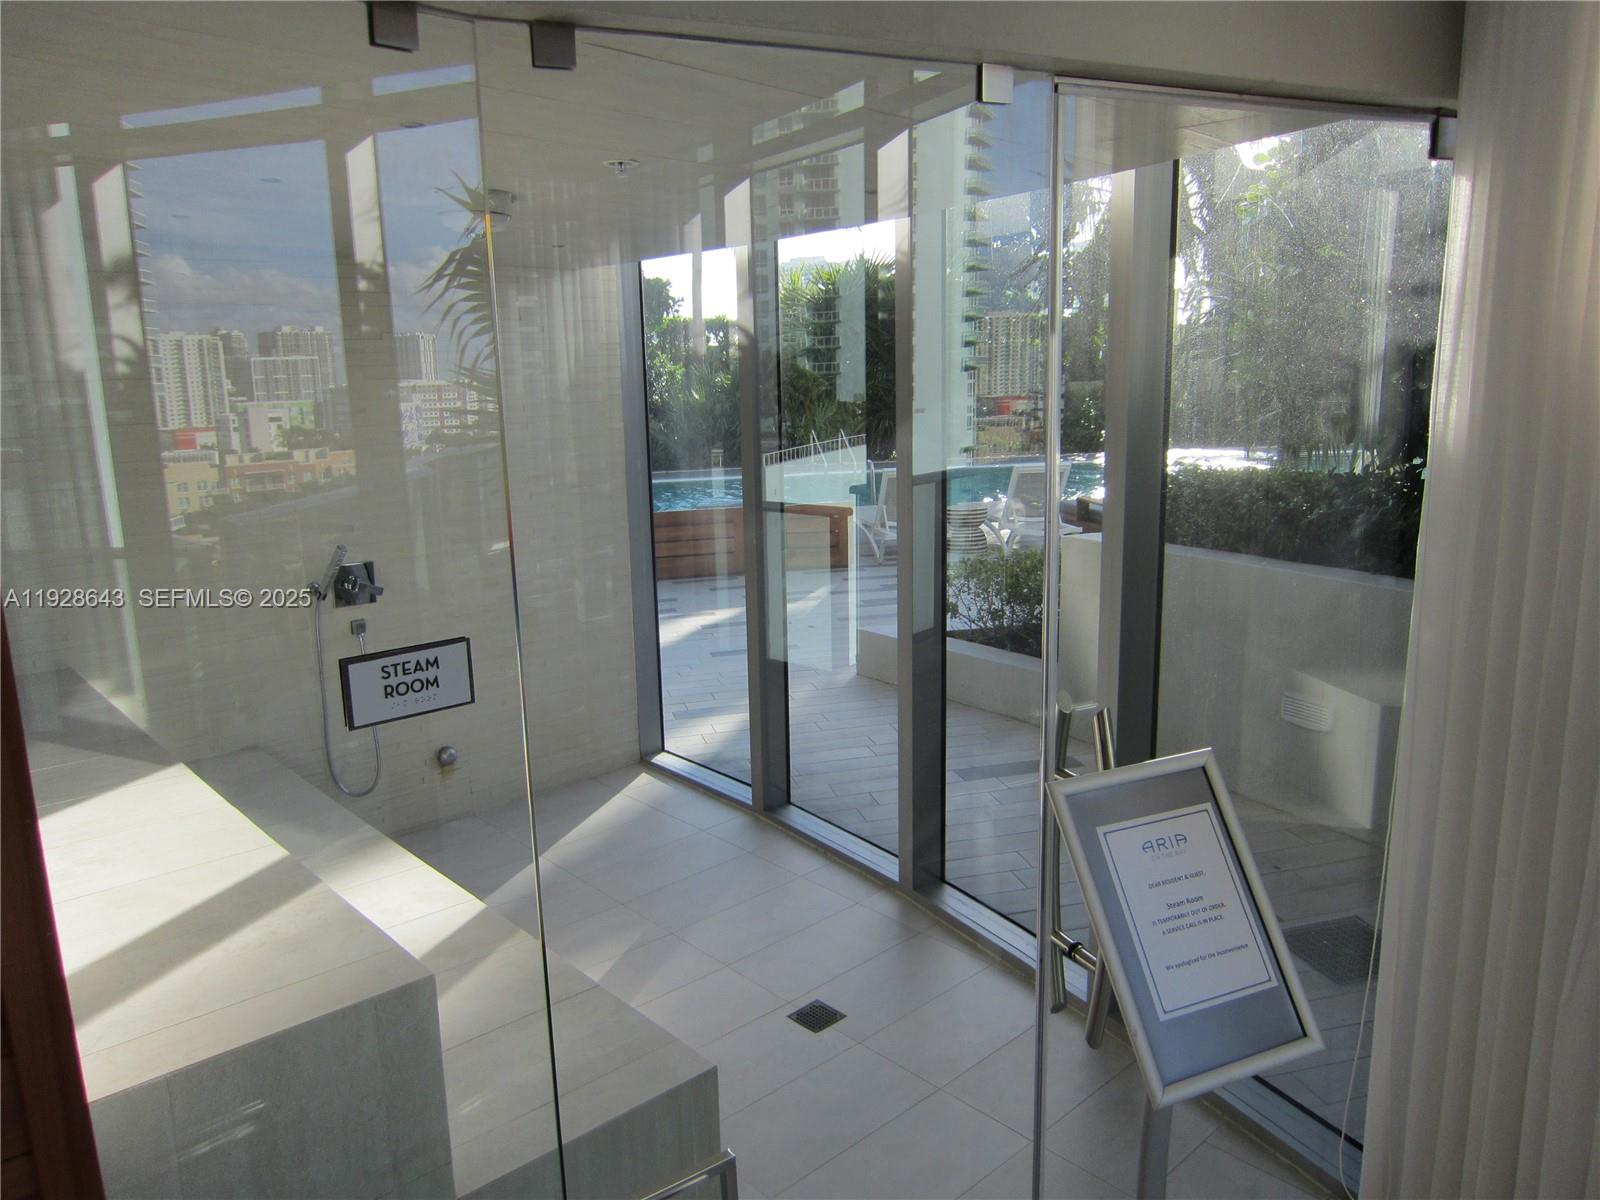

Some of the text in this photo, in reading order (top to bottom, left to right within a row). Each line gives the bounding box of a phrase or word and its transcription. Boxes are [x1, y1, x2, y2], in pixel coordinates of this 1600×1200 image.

[381, 655, 440, 680] STEAM
[383, 675, 440, 699] ROOM
[1141, 833, 1188, 853] ARIA
[1166, 895, 1204, 910] Steam Room
[1190, 908, 1201, 916] OUT
[1166, 923, 1186, 935] SERVICE
[1185, 920, 1198, 929] CALL
